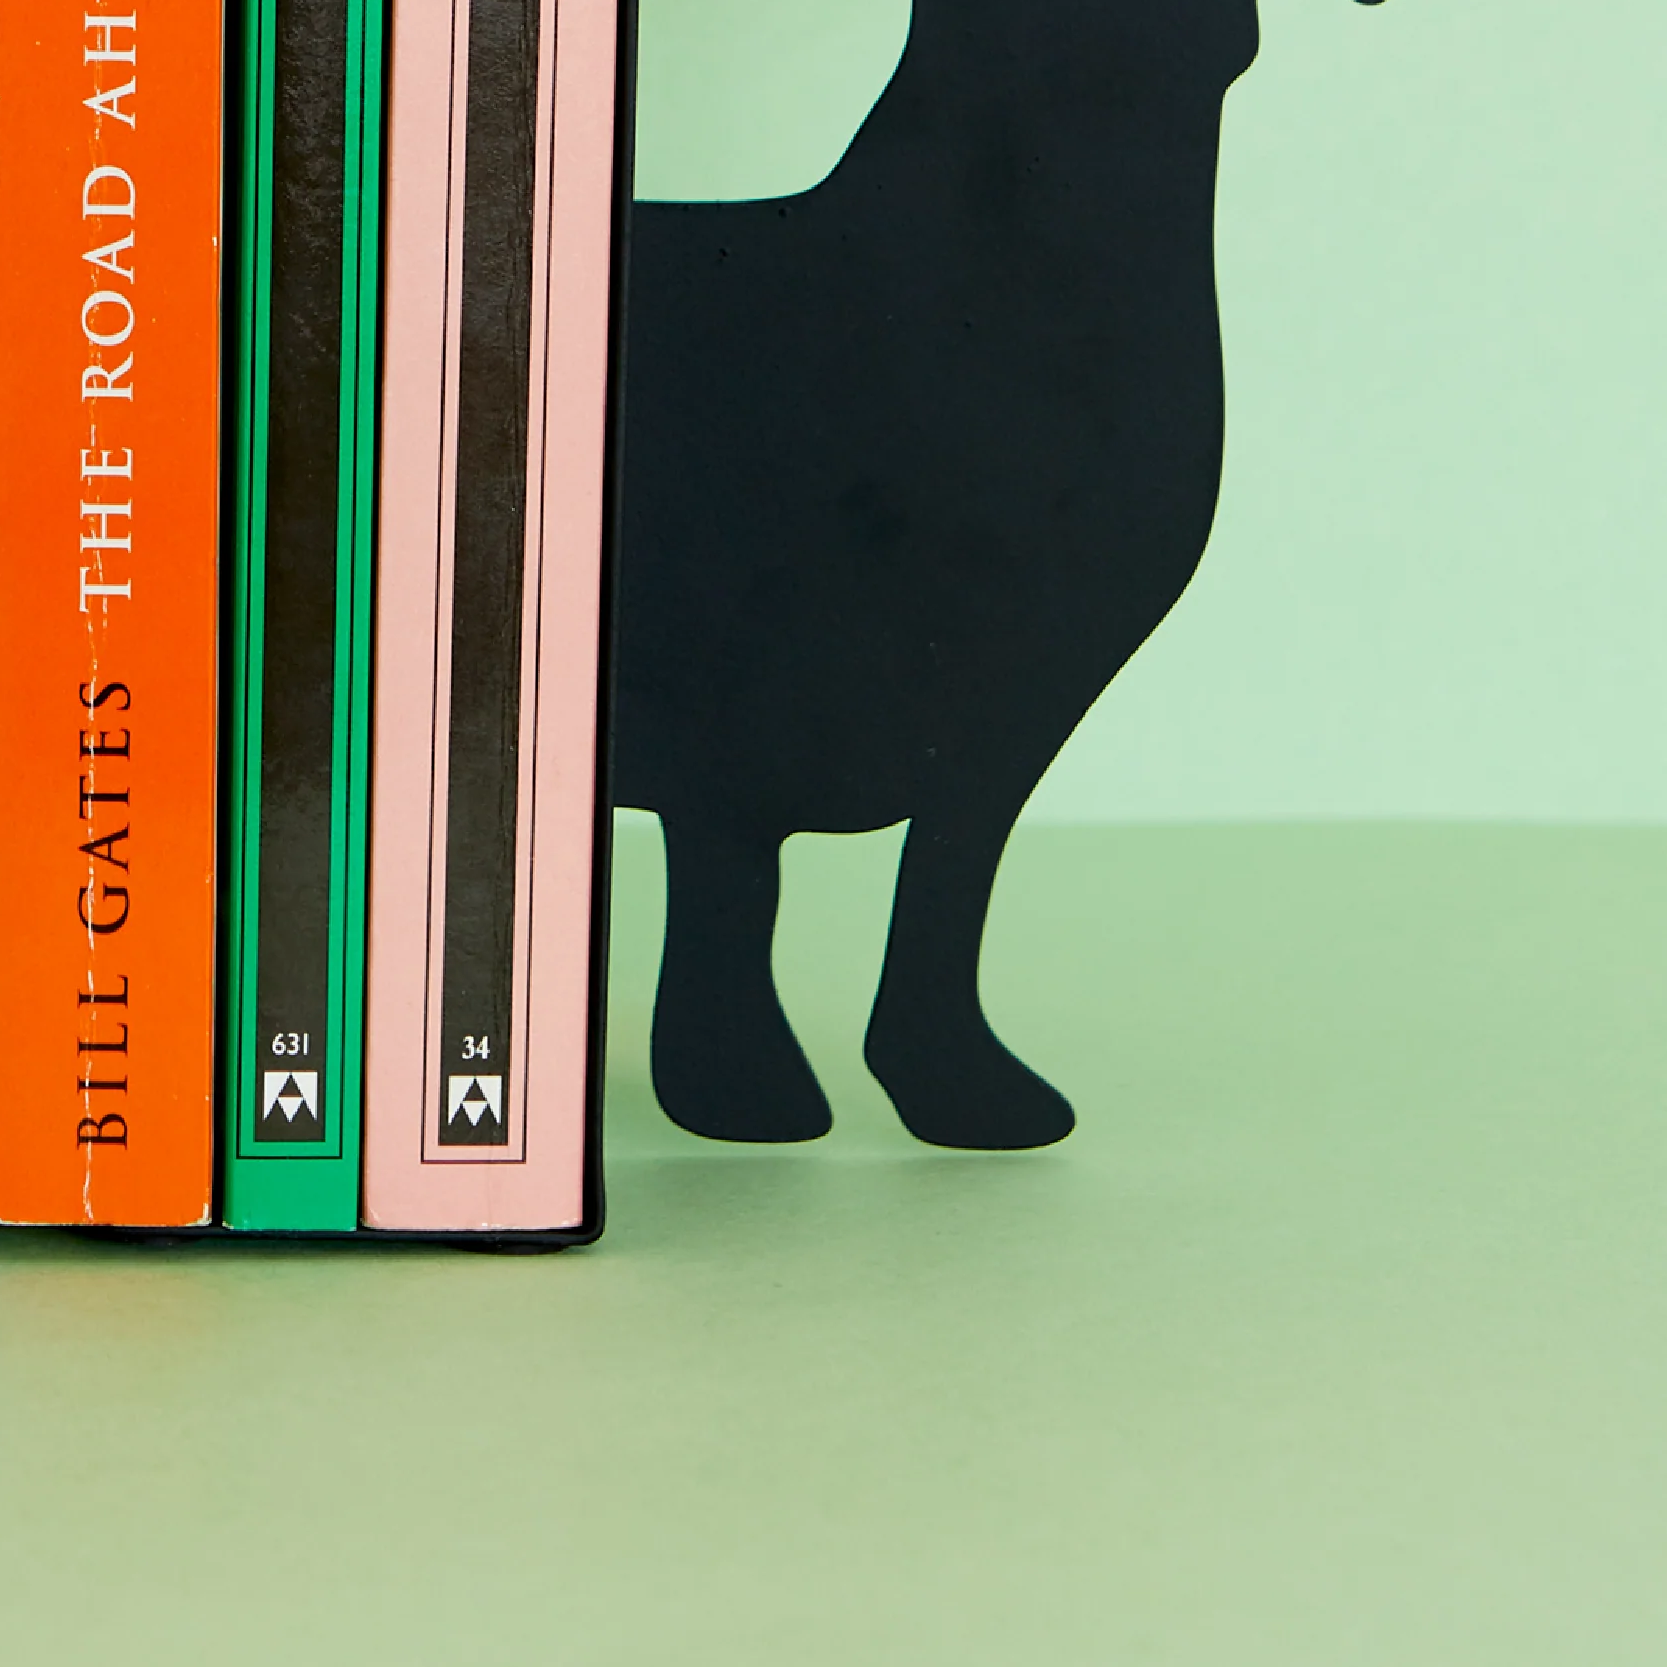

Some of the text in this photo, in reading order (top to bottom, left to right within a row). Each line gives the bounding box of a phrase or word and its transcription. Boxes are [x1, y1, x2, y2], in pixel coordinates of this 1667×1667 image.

[80, 165, 135, 402] ROAD
[79, 445, 133, 612] THE
[76, 681, 131, 1150] BILL GATES
[271, 1033, 309, 1056] 631
[461, 1036, 490, 1059] 34
